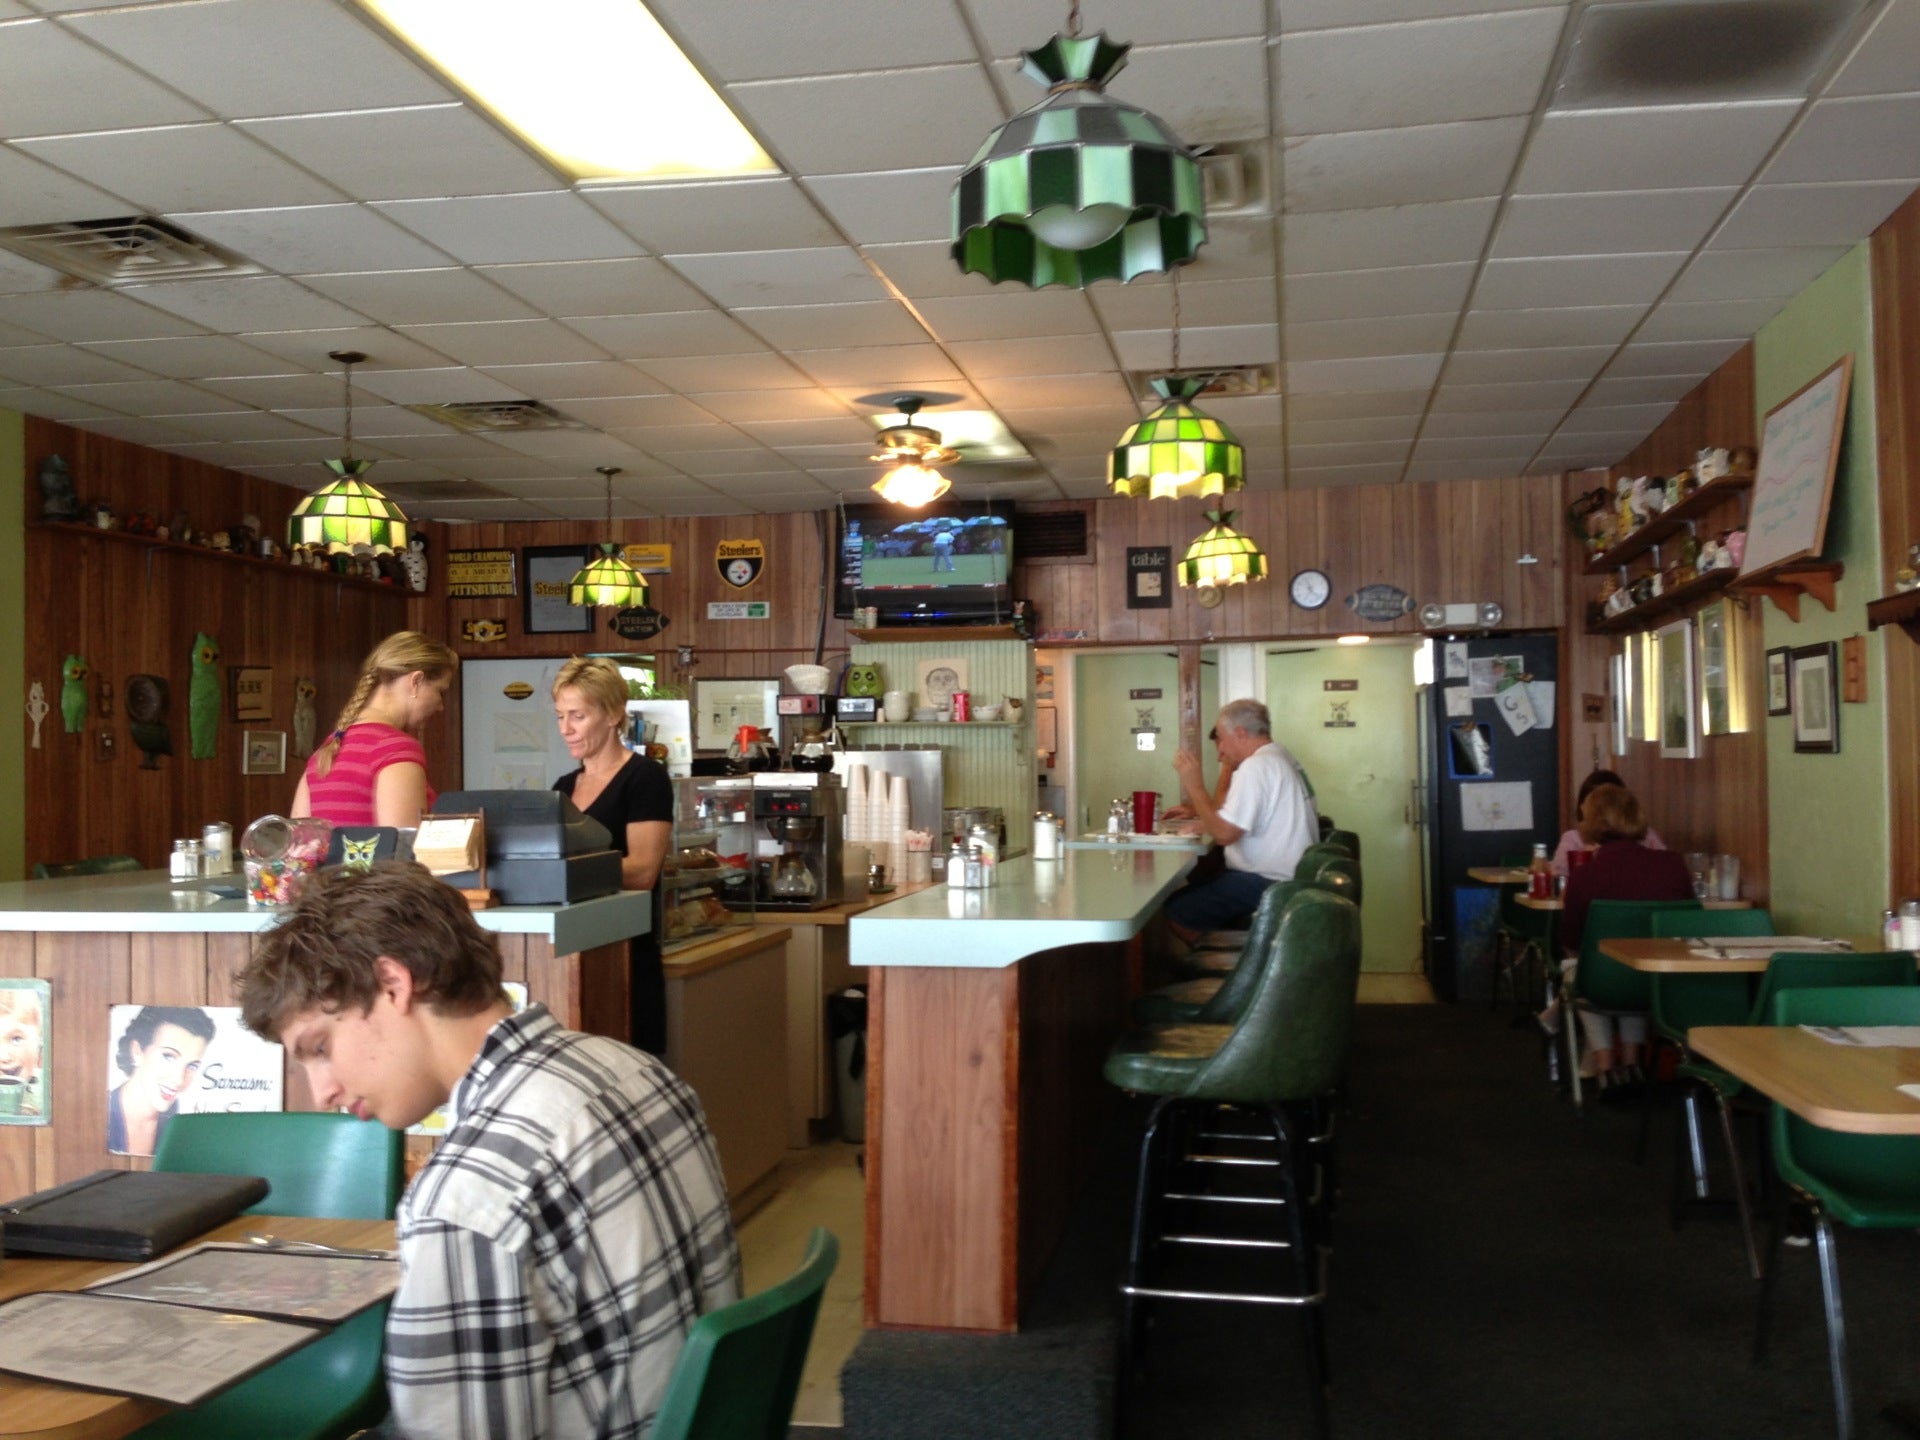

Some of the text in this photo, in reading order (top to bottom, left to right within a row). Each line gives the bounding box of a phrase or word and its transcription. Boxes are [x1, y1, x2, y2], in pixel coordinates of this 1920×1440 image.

[719, 544, 761, 556] Steelers
[448, 583, 512, 595] PITTSBURGH
[202, 1062, 273, 1090] Sarcasm:
